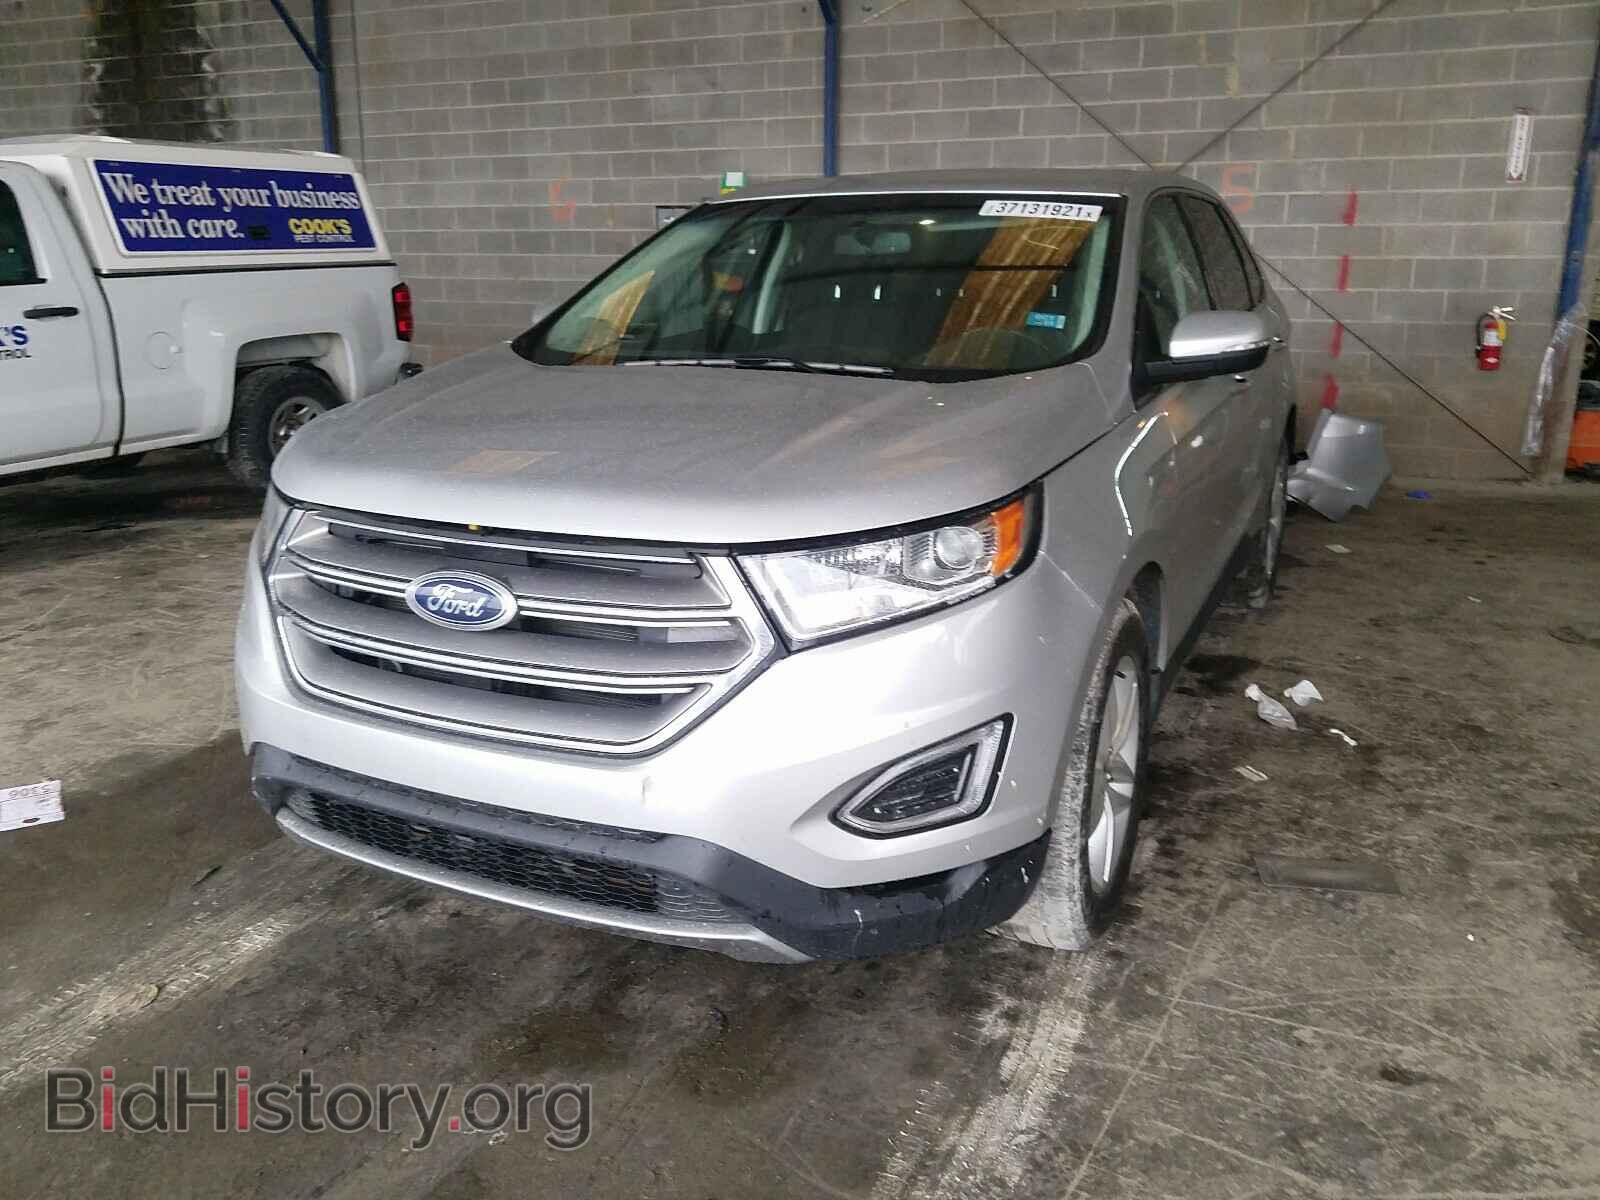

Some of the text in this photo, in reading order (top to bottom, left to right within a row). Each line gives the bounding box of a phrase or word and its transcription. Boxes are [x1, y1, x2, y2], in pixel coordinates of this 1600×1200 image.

[102, 172, 361, 212] We treat your business
[120, 208, 245, 238] with care.
[288, 218, 351, 235] COOK'S
[426, 583, 485, 617] Ford
